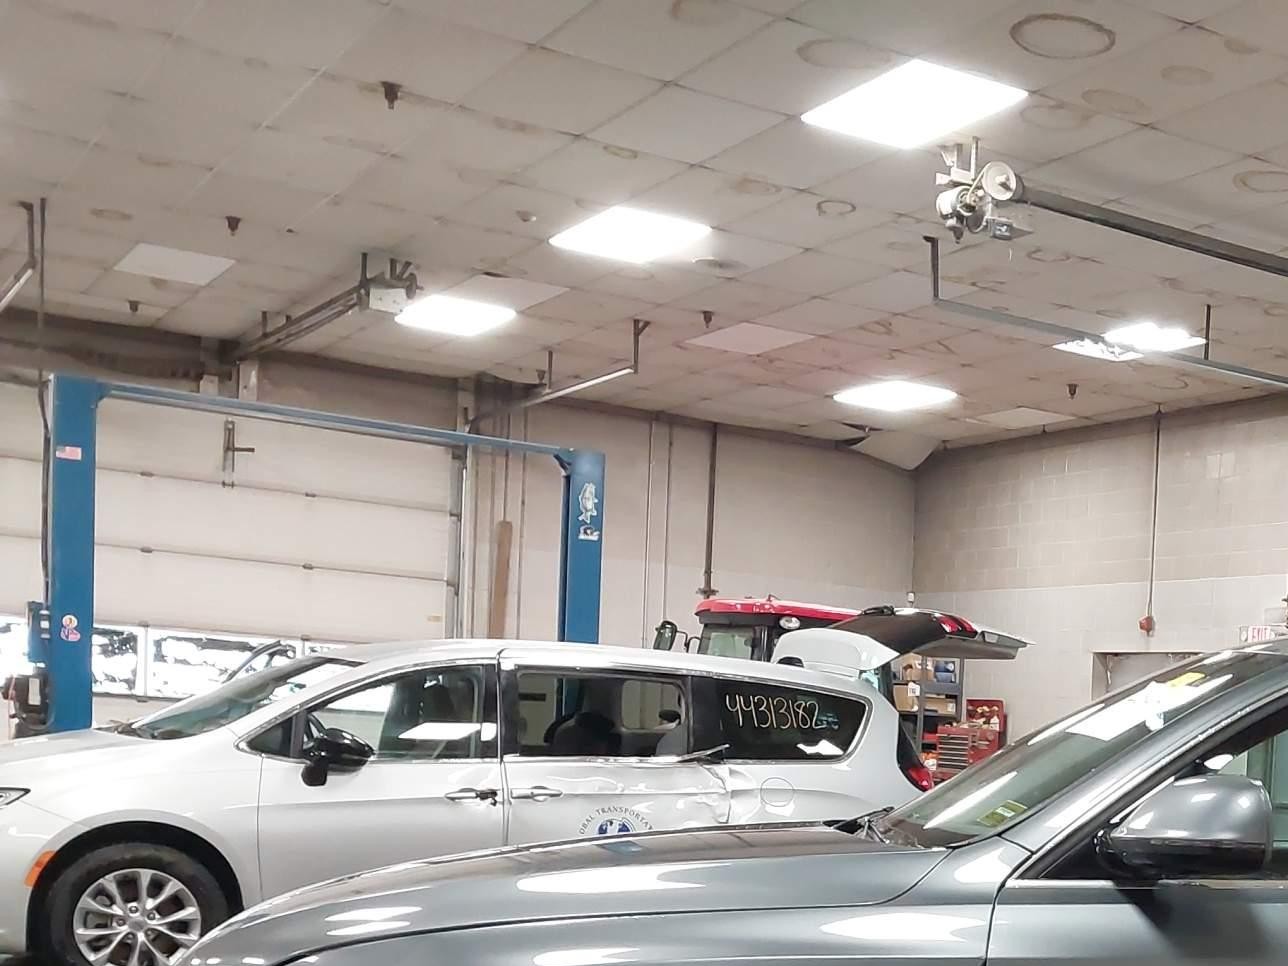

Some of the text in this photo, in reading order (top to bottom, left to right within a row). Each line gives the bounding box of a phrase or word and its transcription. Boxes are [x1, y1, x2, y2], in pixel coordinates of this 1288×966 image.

[1252, 627, 1269, 641] EXIT
[725, 694, 828, 729] 44313182
[579, 806, 654, 834] OBAL TRANSPORTAT
